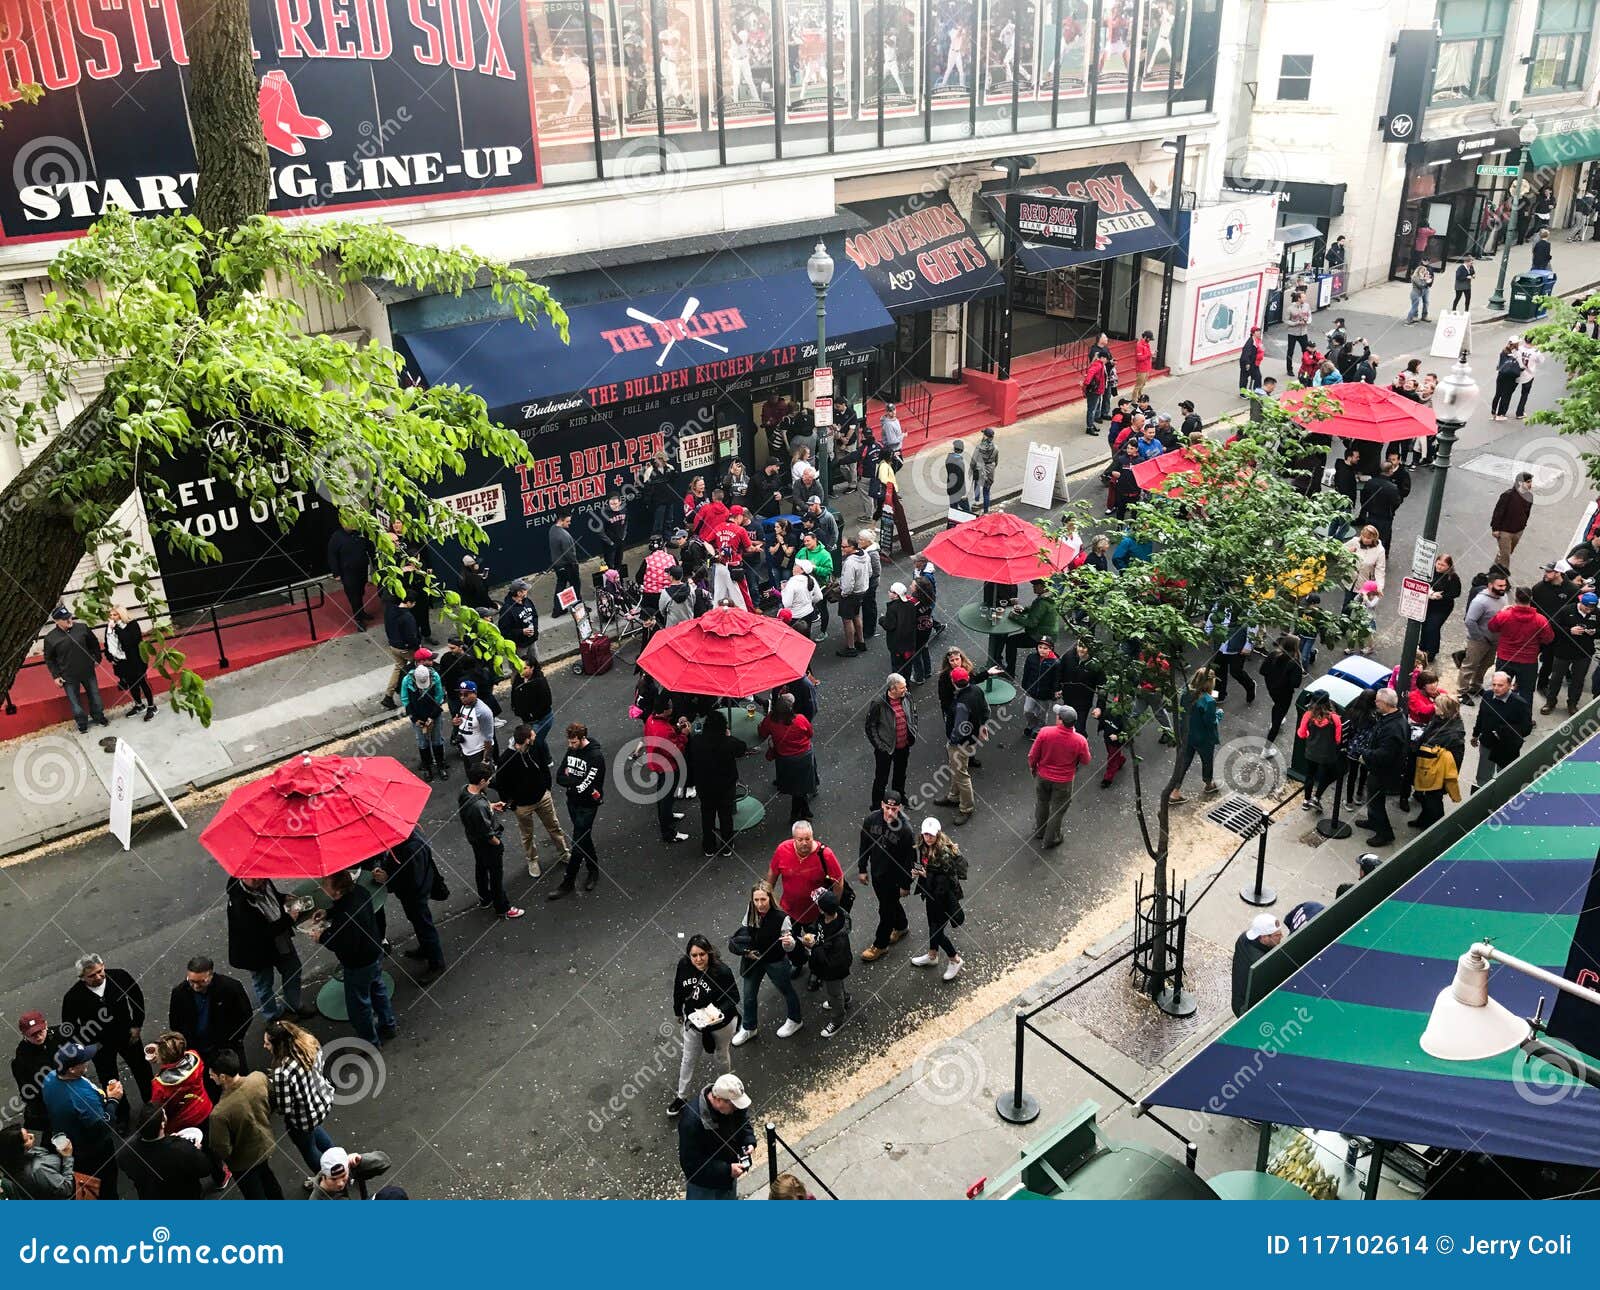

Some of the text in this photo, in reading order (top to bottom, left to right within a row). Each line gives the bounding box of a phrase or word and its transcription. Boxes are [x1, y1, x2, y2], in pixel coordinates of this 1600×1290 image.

[278, 0, 393, 60] RED
[407, 0, 516, 81] SOX
[326, 145, 523, 194] LINE-UP
[1019, 203, 1078, 227] RED SOX
[1098, 213, 1150, 233] STORE
[845, 202, 966, 270] SOUVENIRS
[916, 236, 987, 285] GIFTS
[888, 269, 917, 291] AND
[600, 307, 748, 354] THE BULLPEN
[839, 353, 870, 368] FULL BAR
[521, 398, 584, 420] Budweiser
[587, 384, 619, 407] THE
[624, 368, 690, 400] BULLPEN
[695, 354, 754, 384] KITCHEN
[772, 346, 797, 366] TAP
[801, 341, 847, 358] Buweiser
[520, 427, 537, 439] HOT
[540, 422, 560, 435] DOGS
[569, 415, 588, 428] KIDS
[590, 410, 614, 424] MENU
[623, 405, 643, 417] FULL
[645, 400, 660, 411] BAR
[683, 391, 700, 403] COLD
[701, 386, 718, 398] BEER
[682, 437, 699, 451] THE
[515, 454, 563, 492] THE
[571, 431, 666, 479] BULLPEN
[157, 477, 217, 512] LET
[456, 487, 500, 510] BULLPEN
[481, 500, 498, 512] TAP
[520, 472, 607, 517] KITCHEN
[578, 500, 610, 515] PARK
[174, 507, 239, 537] YOU
[682, 977, 698, 988] RED
